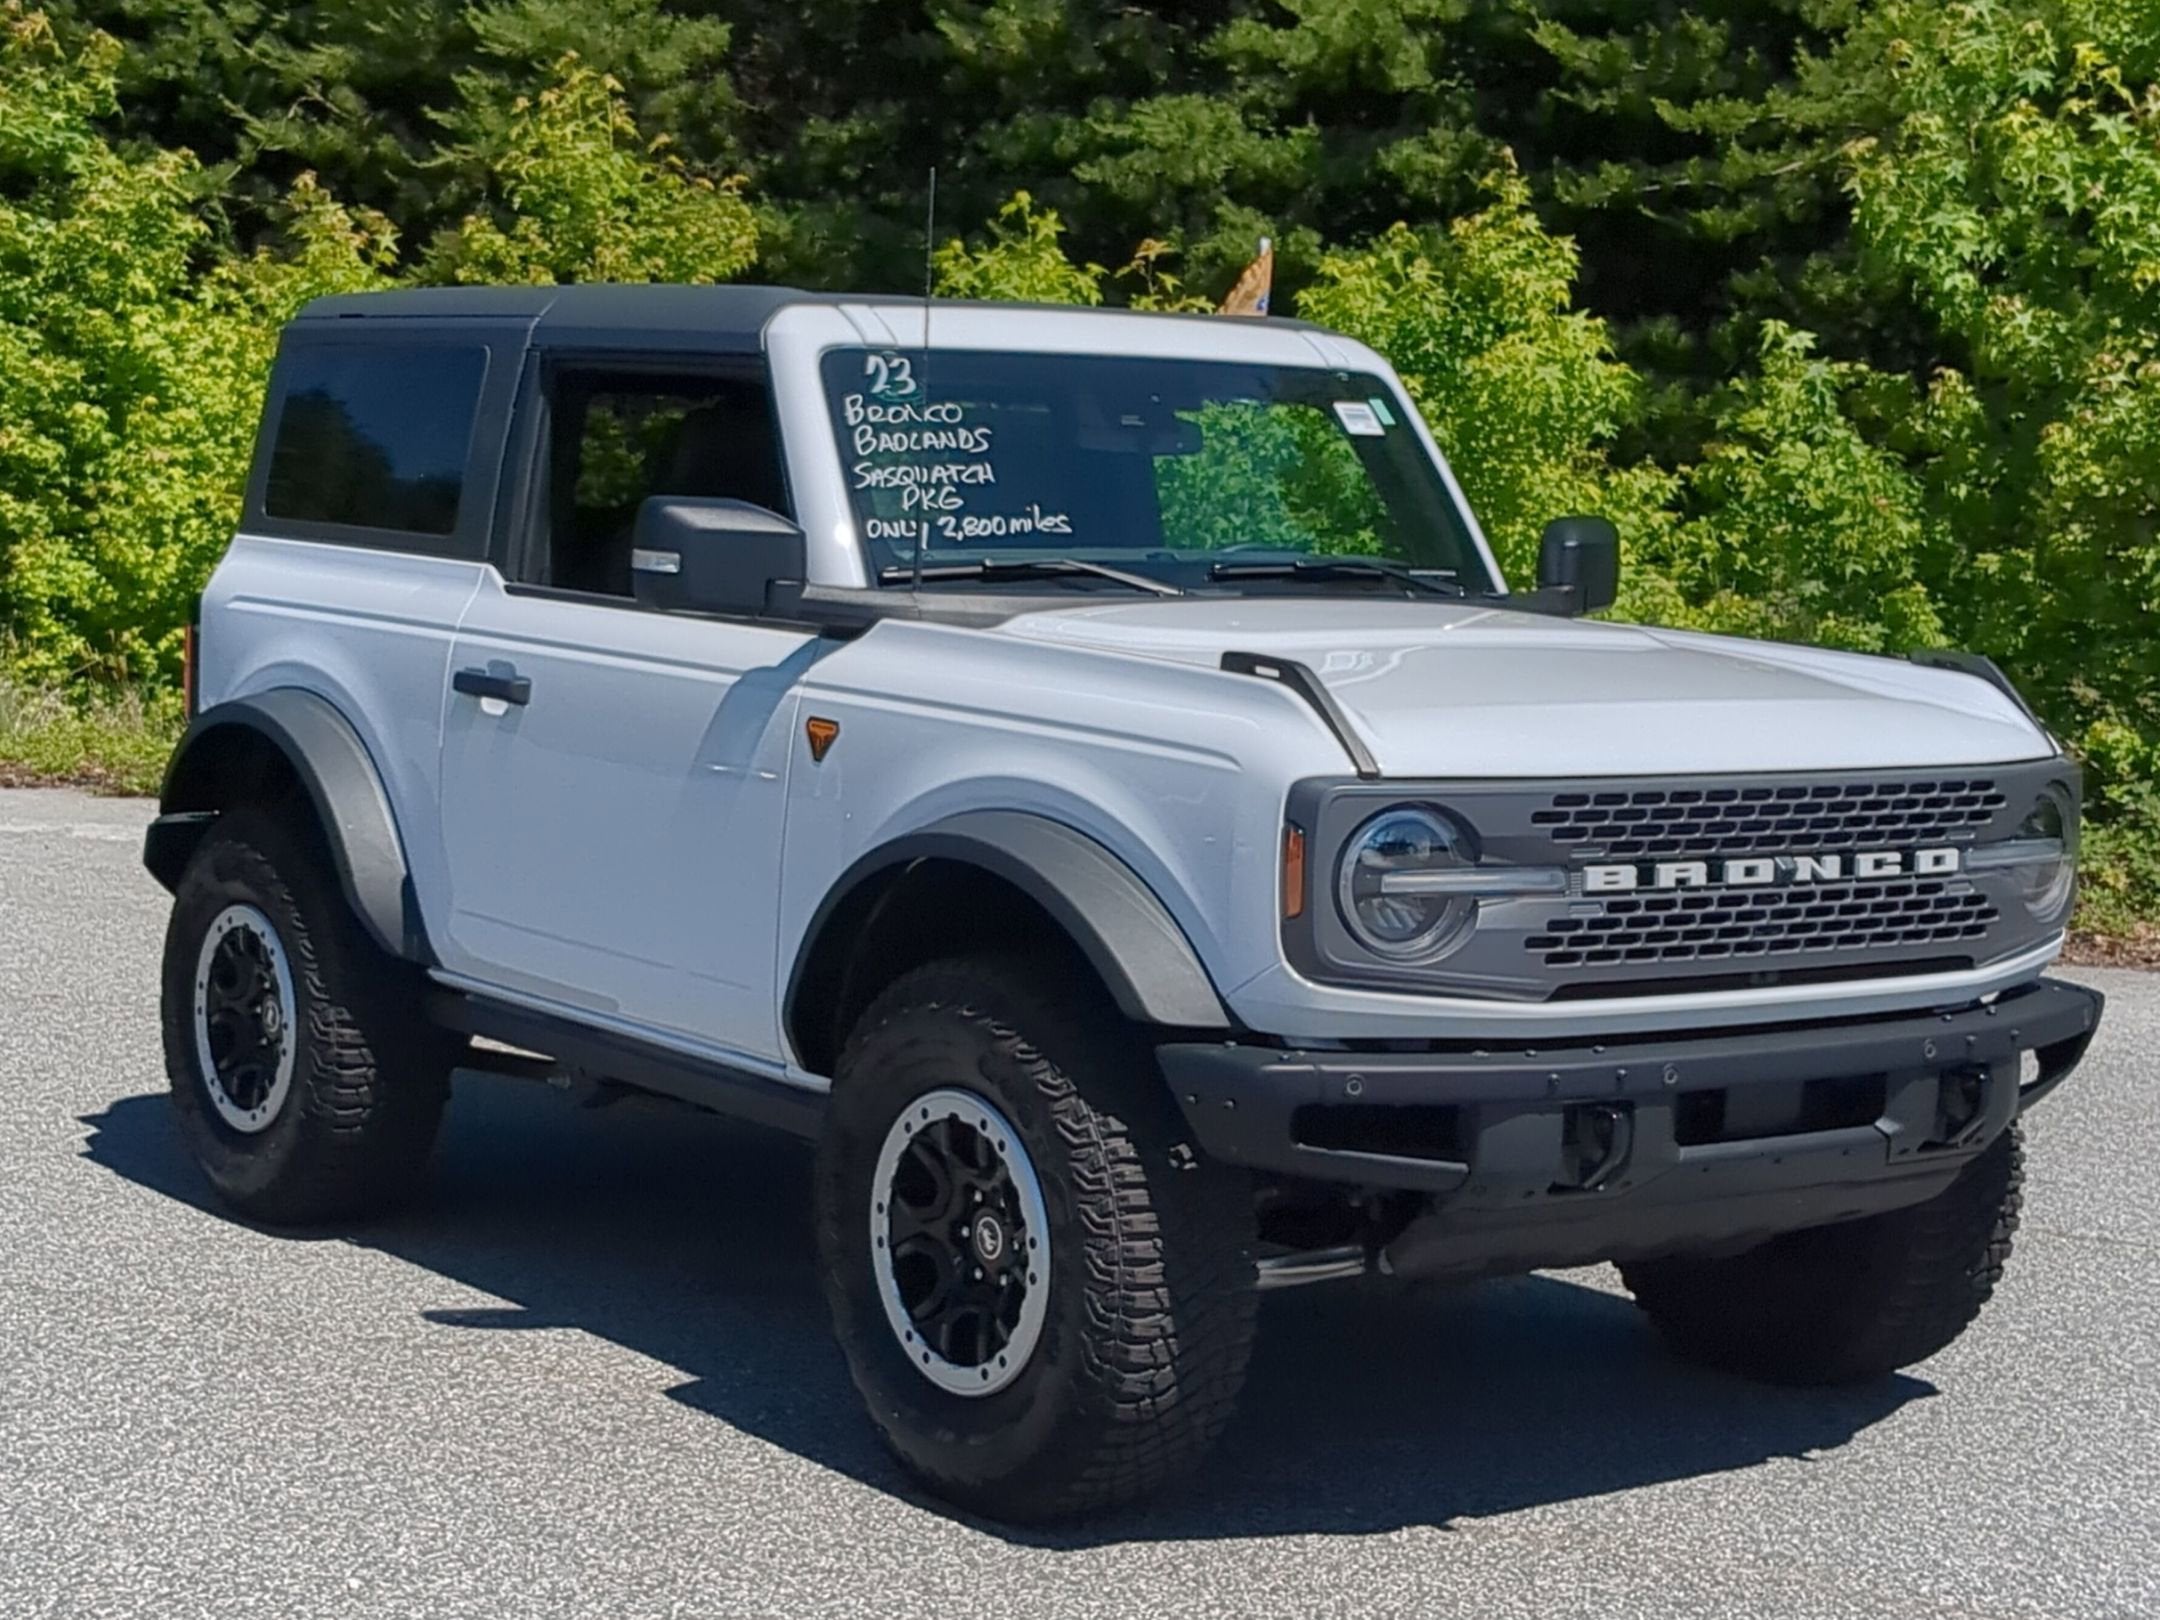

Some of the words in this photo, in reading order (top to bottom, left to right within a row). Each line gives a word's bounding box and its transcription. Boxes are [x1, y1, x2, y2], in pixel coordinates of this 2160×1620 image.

[854, 425, 992, 456] BADLANDS
[853, 462, 996, 489] SASQUATCH
[902, 487, 964, 511] PKG
[866, 518, 929, 550] ONLY
[936, 516, 1006, 541] 2,800
[1009, 504, 1073, 534] miles
[1582, 847, 1960, 893] BRONCO
